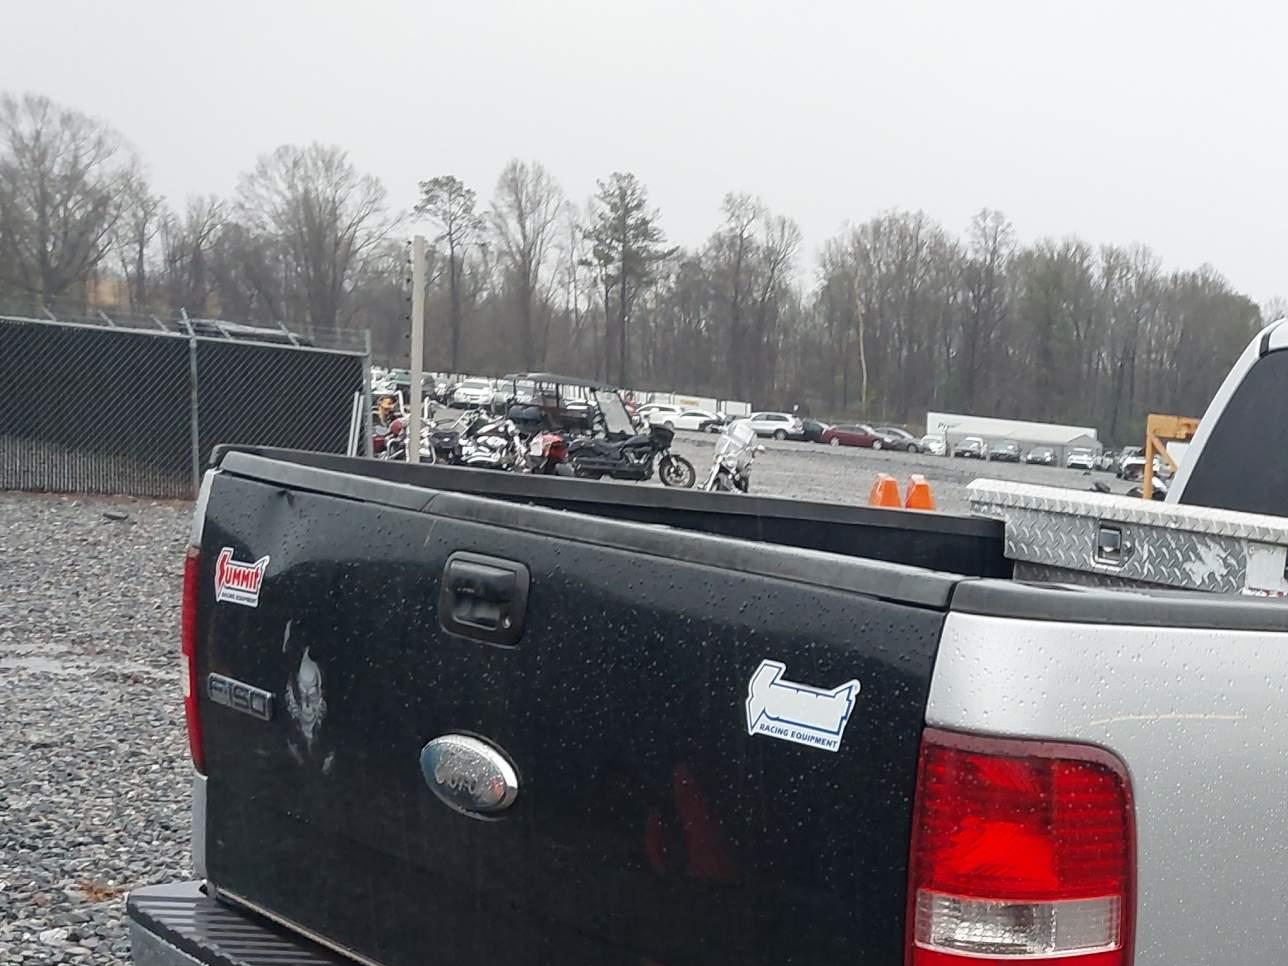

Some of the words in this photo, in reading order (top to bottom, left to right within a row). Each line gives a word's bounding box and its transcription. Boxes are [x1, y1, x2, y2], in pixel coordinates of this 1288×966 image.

[217, 552, 265, 593] SUMMIT
[760, 723, 789, 737] RACING
[790, 731, 838, 749] EQUIPMENT
